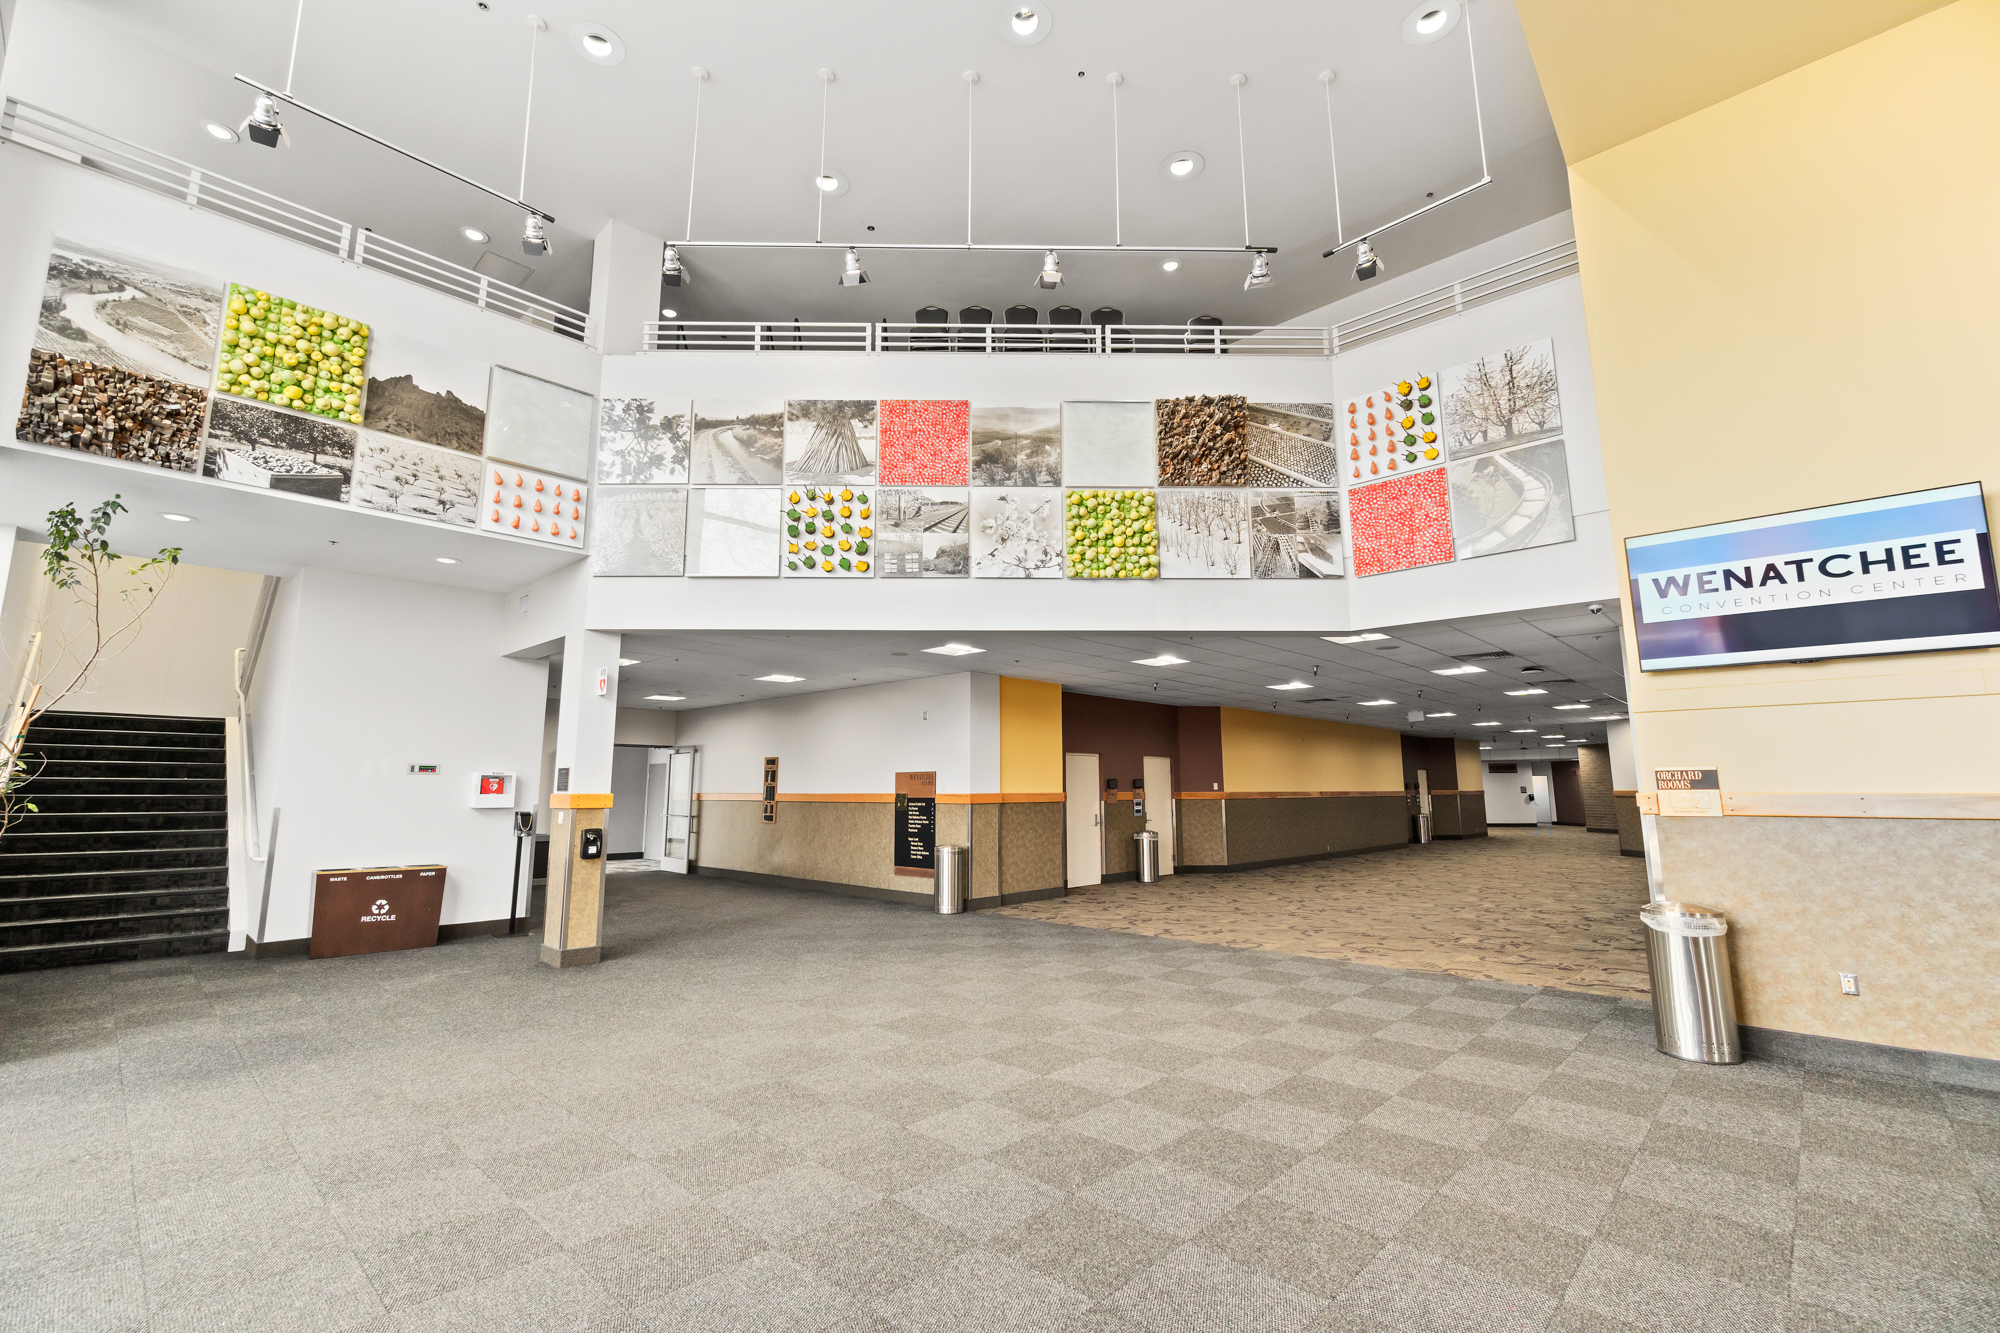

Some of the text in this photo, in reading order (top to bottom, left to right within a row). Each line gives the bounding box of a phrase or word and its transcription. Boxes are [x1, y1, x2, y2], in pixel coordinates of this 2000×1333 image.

[1651, 538, 1966, 600] WENATCHEE
[1661, 572, 1968, 616] CONVENTION CENTER
[1657, 770, 1702, 780] ORCHARD
[1658, 780, 1691, 789] ROOMS
[361, 914, 396, 922] RECYCLE
